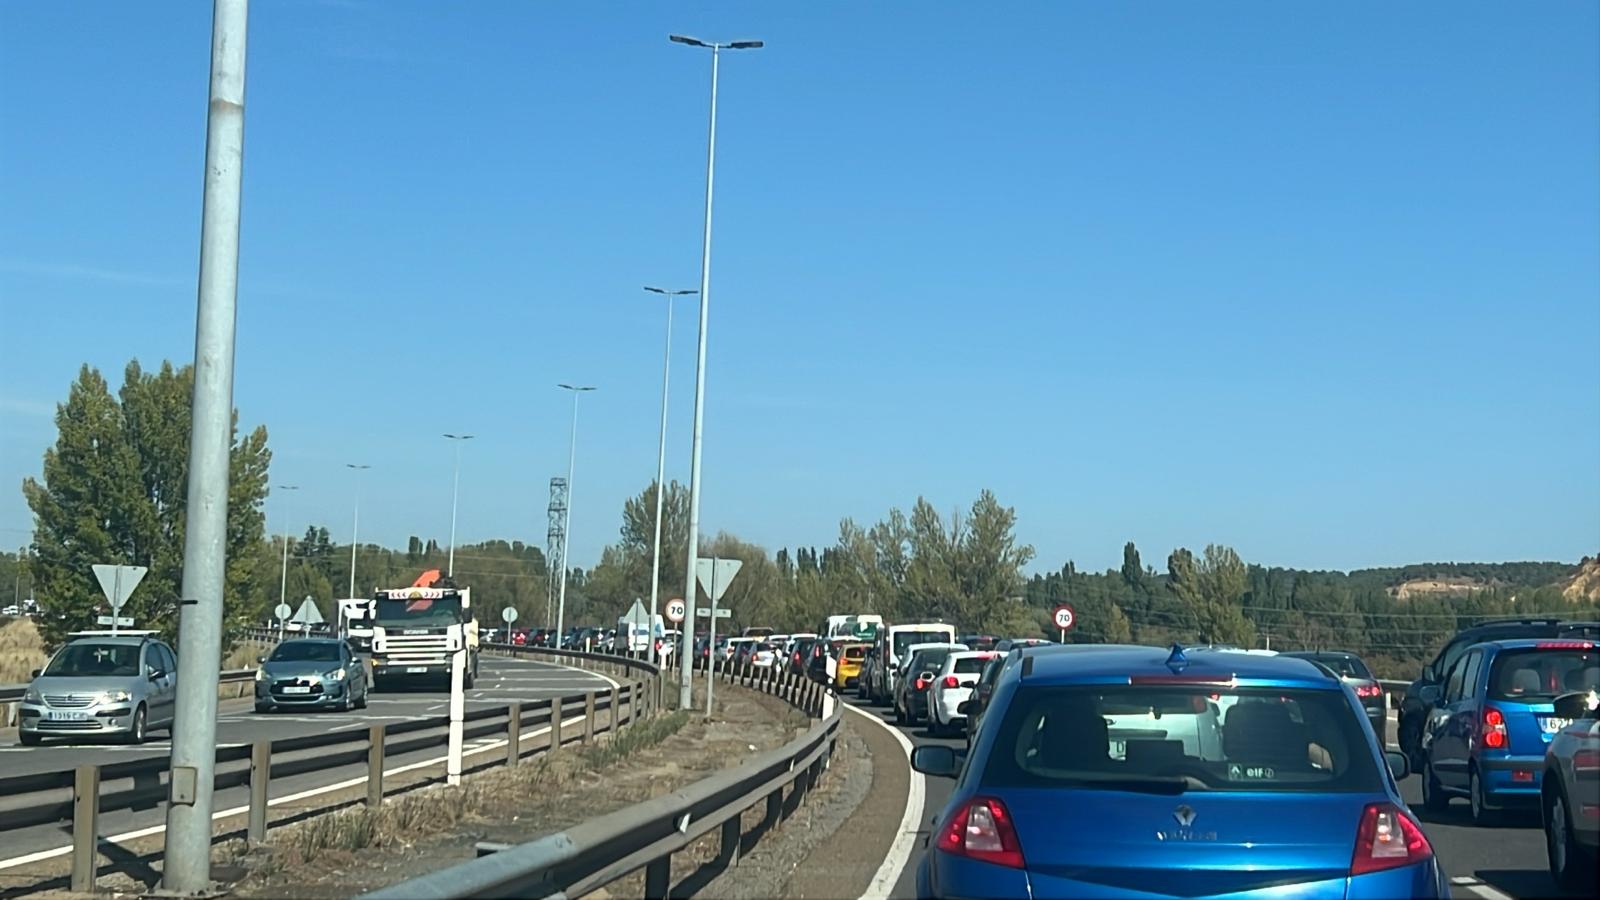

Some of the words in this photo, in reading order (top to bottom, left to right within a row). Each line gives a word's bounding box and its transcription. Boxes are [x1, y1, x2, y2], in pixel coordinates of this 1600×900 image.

[671, 606, 684, 615] 70
[1059, 614, 1070, 623] 70
[1246, 767, 1264, 778] elf
